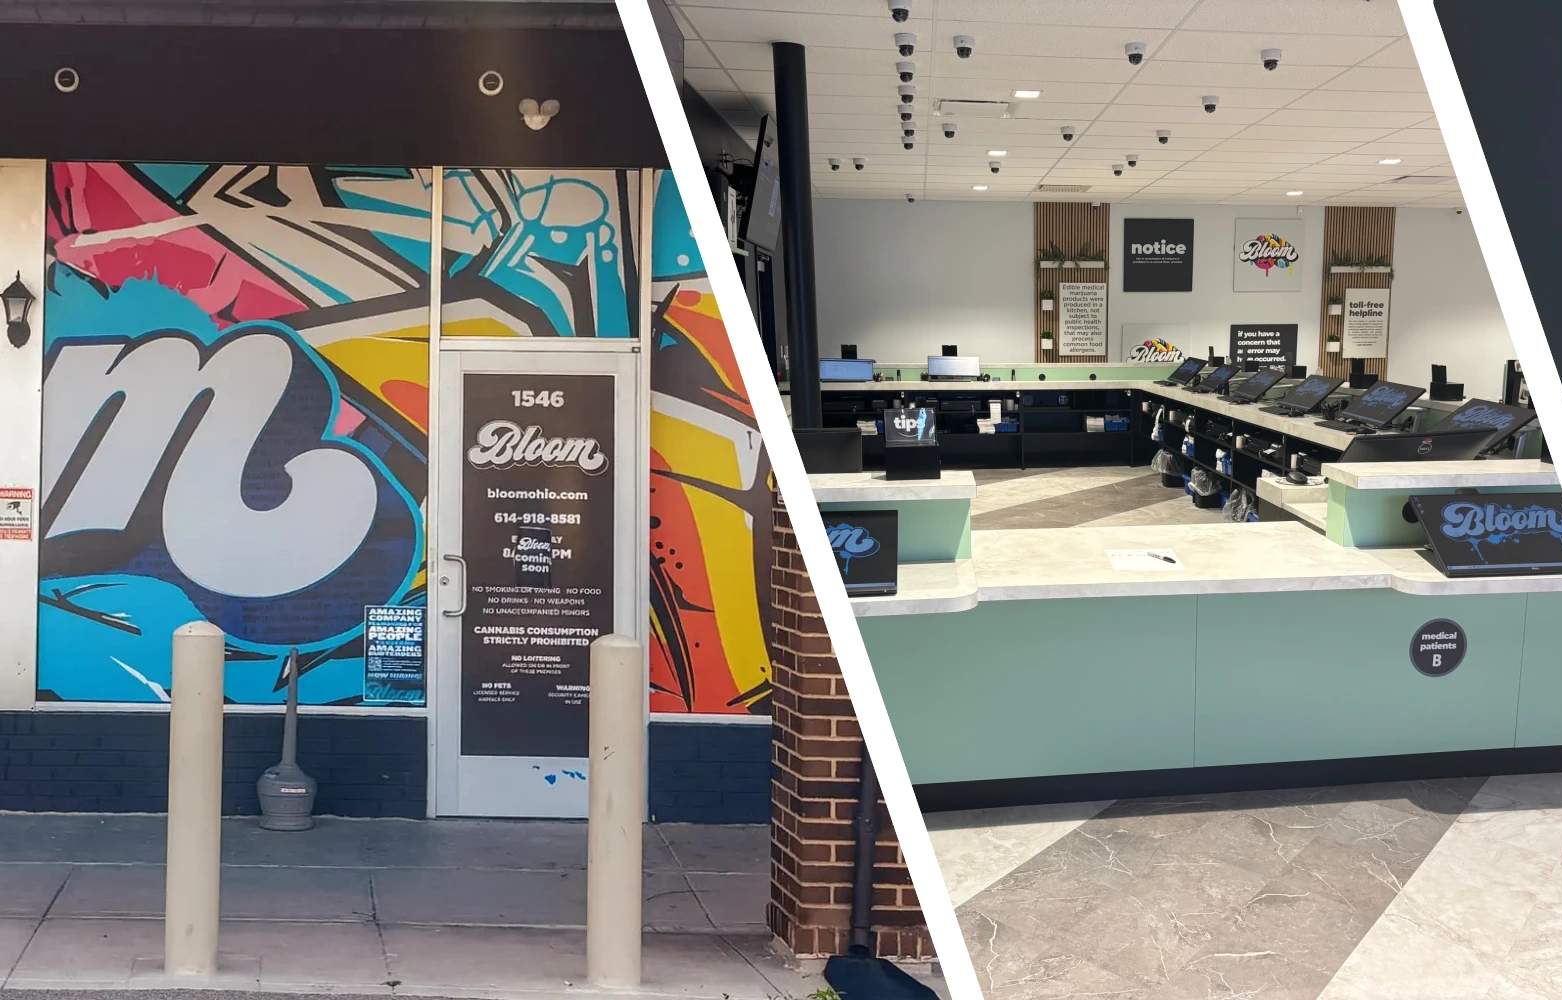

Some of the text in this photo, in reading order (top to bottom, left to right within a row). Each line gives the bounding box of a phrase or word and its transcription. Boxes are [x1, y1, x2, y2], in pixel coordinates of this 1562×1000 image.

[1131, 239, 1187, 255] notice
[1239, 240, 1298, 262] Bloom
[1349, 301, 1384, 309] toll-free
[1349, 309, 1383, 318] helpline
[1244, 331, 1257, 339] you
[1127, 344, 1185, 363] Bloom
[511, 390, 565, 408] 1546
[467, 420, 607, 474] Bloom
[487, 488, 588, 500] bloomohio.com
[494, 512, 581, 525] 614-918-8581
[521, 564, 549, 573] soon
[474, 626, 599, 636] CANNABIS CONSUMPTION
[1421, 631, 1457, 641] medical
[368, 633, 422, 641] PEOPLE
[483, 636, 590, 646] STRICTLY PROHIBITED
[1420, 641, 1457, 652] patients
[1432, 654, 1442, 667] B
